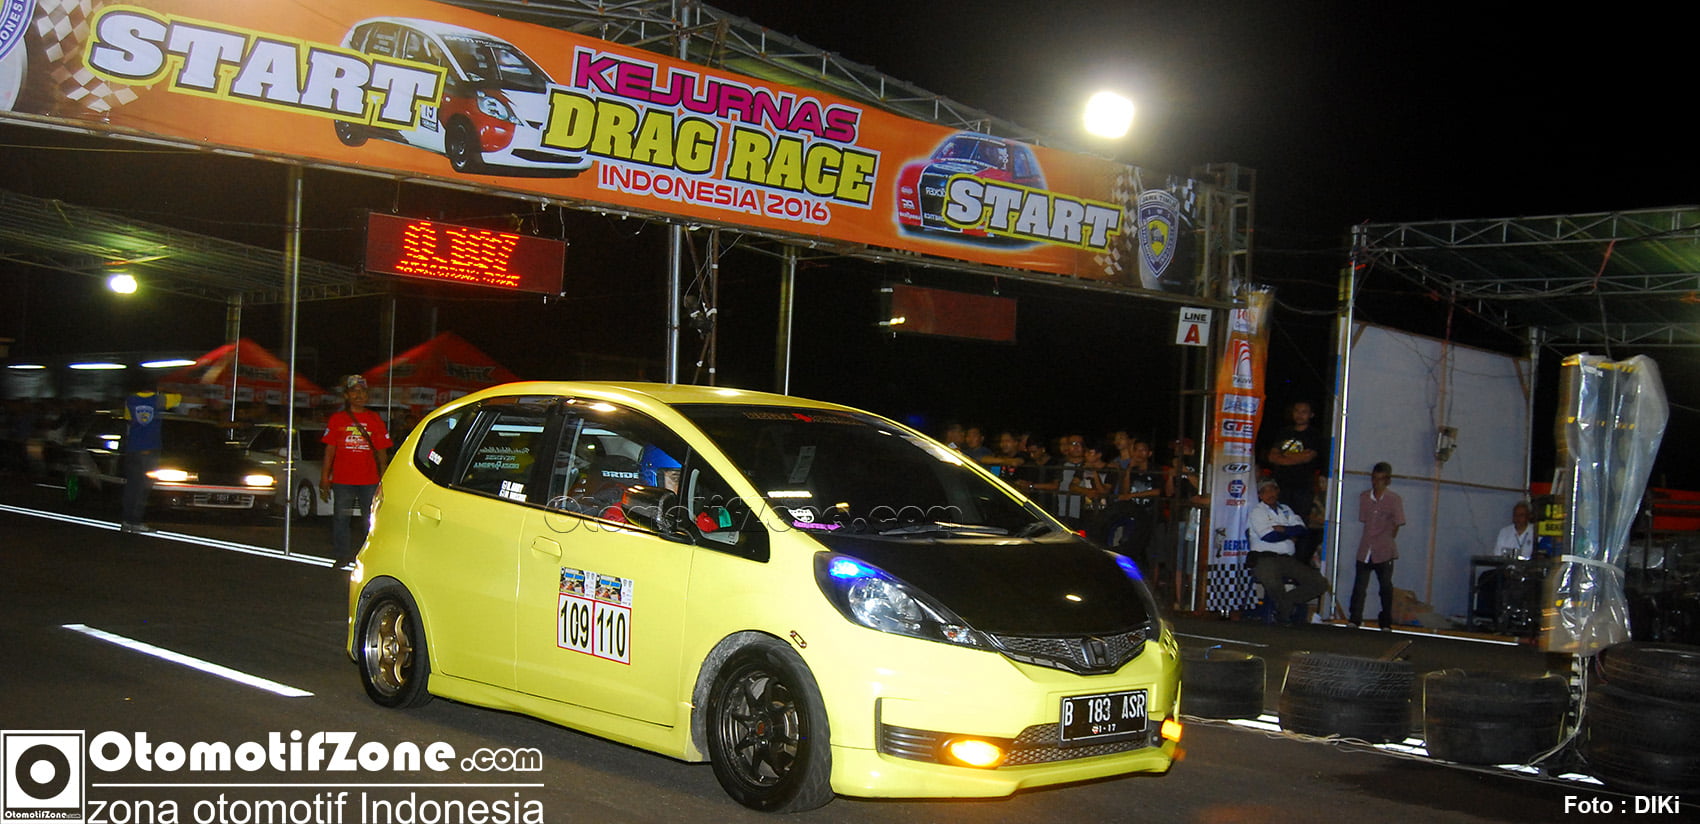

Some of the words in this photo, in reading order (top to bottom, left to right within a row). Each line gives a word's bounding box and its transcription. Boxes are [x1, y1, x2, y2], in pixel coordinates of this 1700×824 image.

[87, 7, 442, 125] START
[575, 49, 860, 144] KEJURNAS
[541, 88, 718, 174] DRAG
[727, 126, 880, 206] RACE
[602, 164, 758, 211] INDONESIA
[766, 194, 829, 223] 2016
[946, 176, 1122, 250] START
[1184, 312, 1207, 322] LINE
[1184, 324, 1200, 344] A
[601, 470, 639, 479] BRIDE
[560, 599, 589, 649] 109
[596, 607, 626, 658] 110
[1064, 701, 1074, 727] B
[1088, 698, 1111, 724] 183
[1121, 694, 1145, 719] ASR
